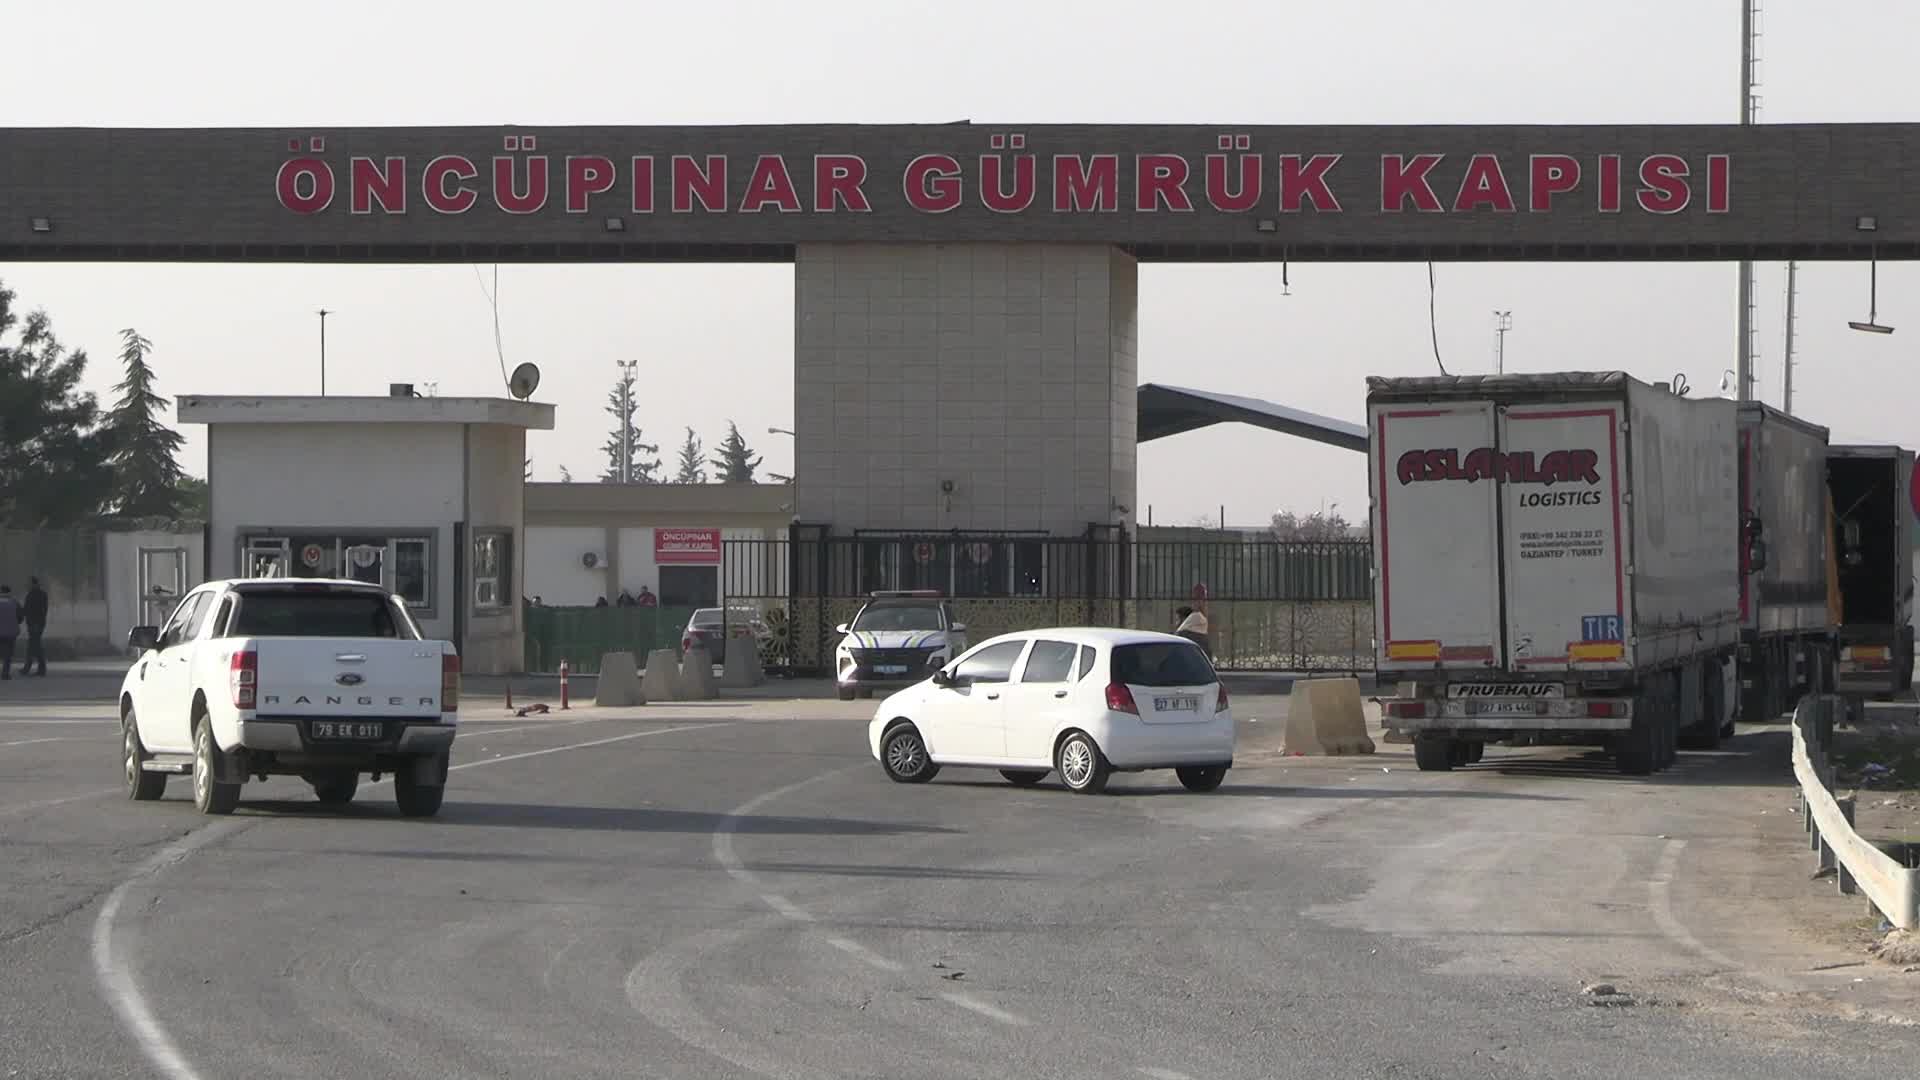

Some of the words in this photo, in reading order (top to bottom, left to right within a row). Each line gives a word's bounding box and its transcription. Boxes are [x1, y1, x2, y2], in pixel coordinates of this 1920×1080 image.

[275, 136, 872, 214] ÖNCÜPINAR
[903, 134, 1343, 213] GÜMRÜK
[1380, 154, 1731, 213] KAPISI
[1397, 448, 1600, 486] ASLANLAR
[1520, 491, 1601, 507] LOGISTICS
[1585, 617, 1619, 640] TIR
[264, 695, 434, 706] RANGER
